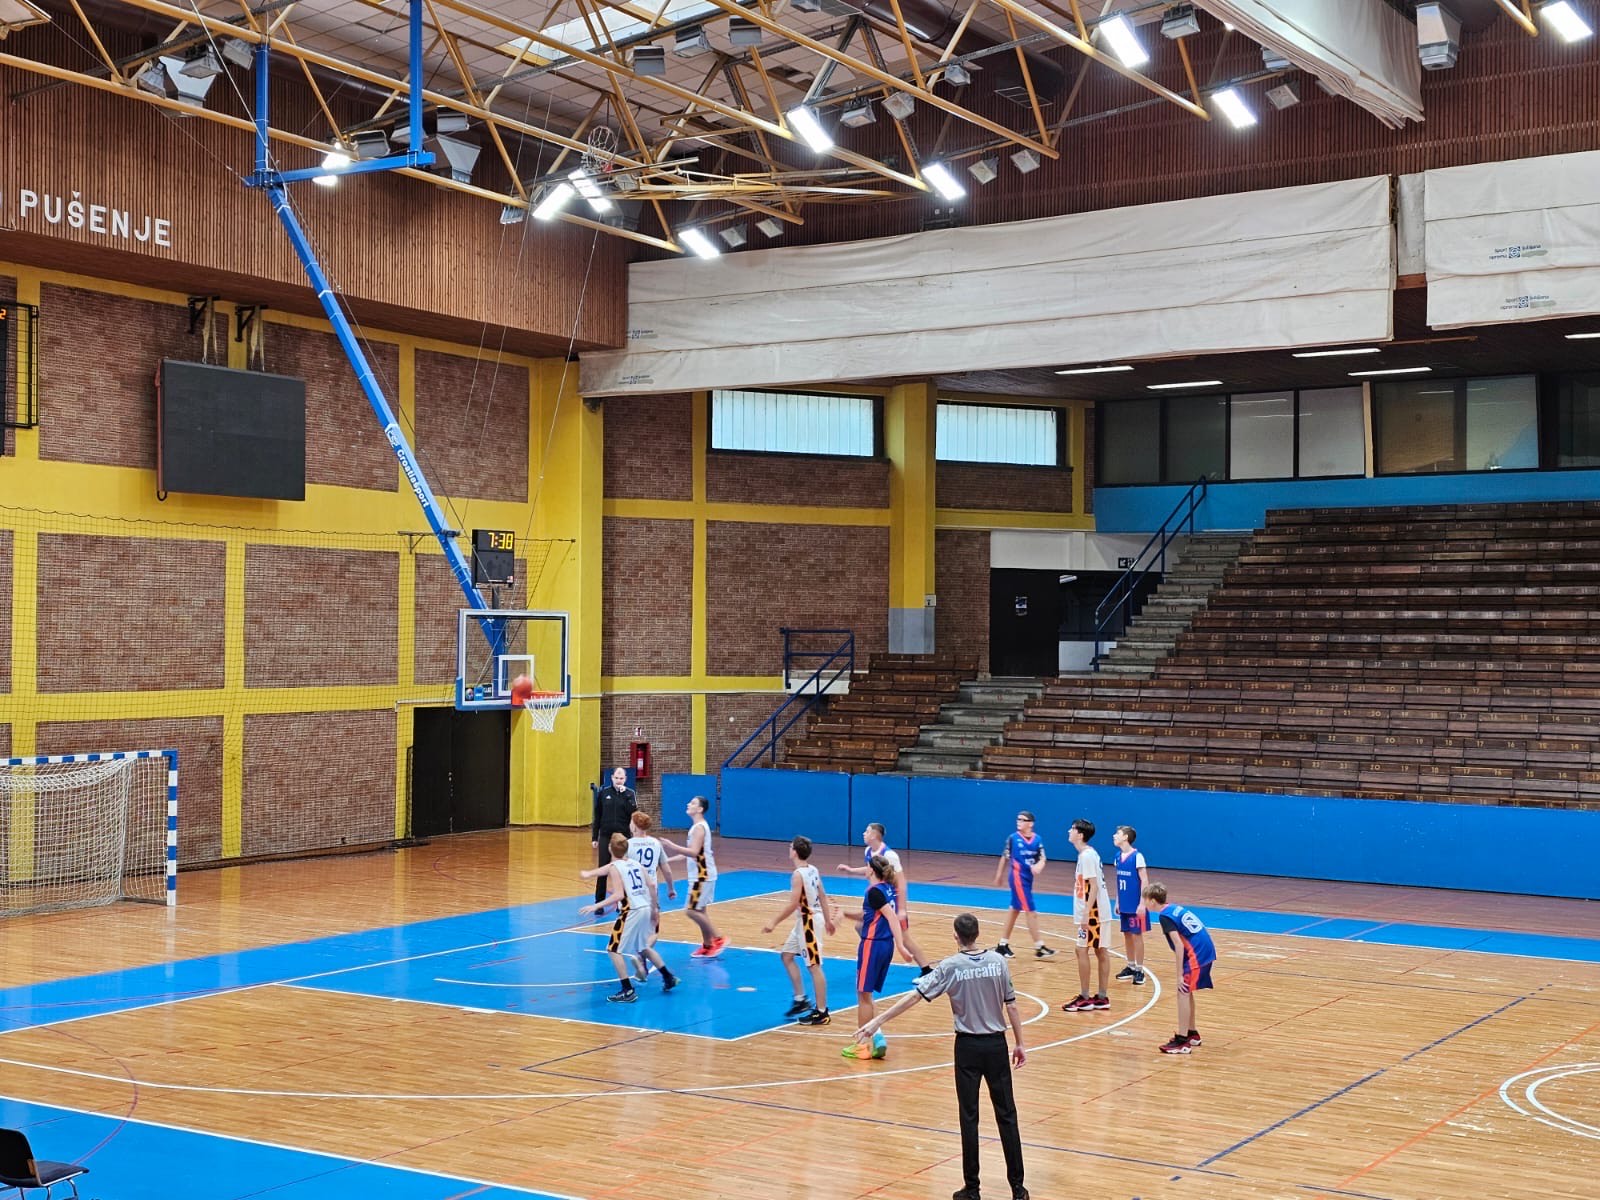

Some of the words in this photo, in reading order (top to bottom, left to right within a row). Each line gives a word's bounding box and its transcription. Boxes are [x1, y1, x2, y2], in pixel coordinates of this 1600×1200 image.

[20, 189, 171, 248] PUŠENJE
[636, 848, 654, 868] 19
[628, 869, 642, 890] 15
